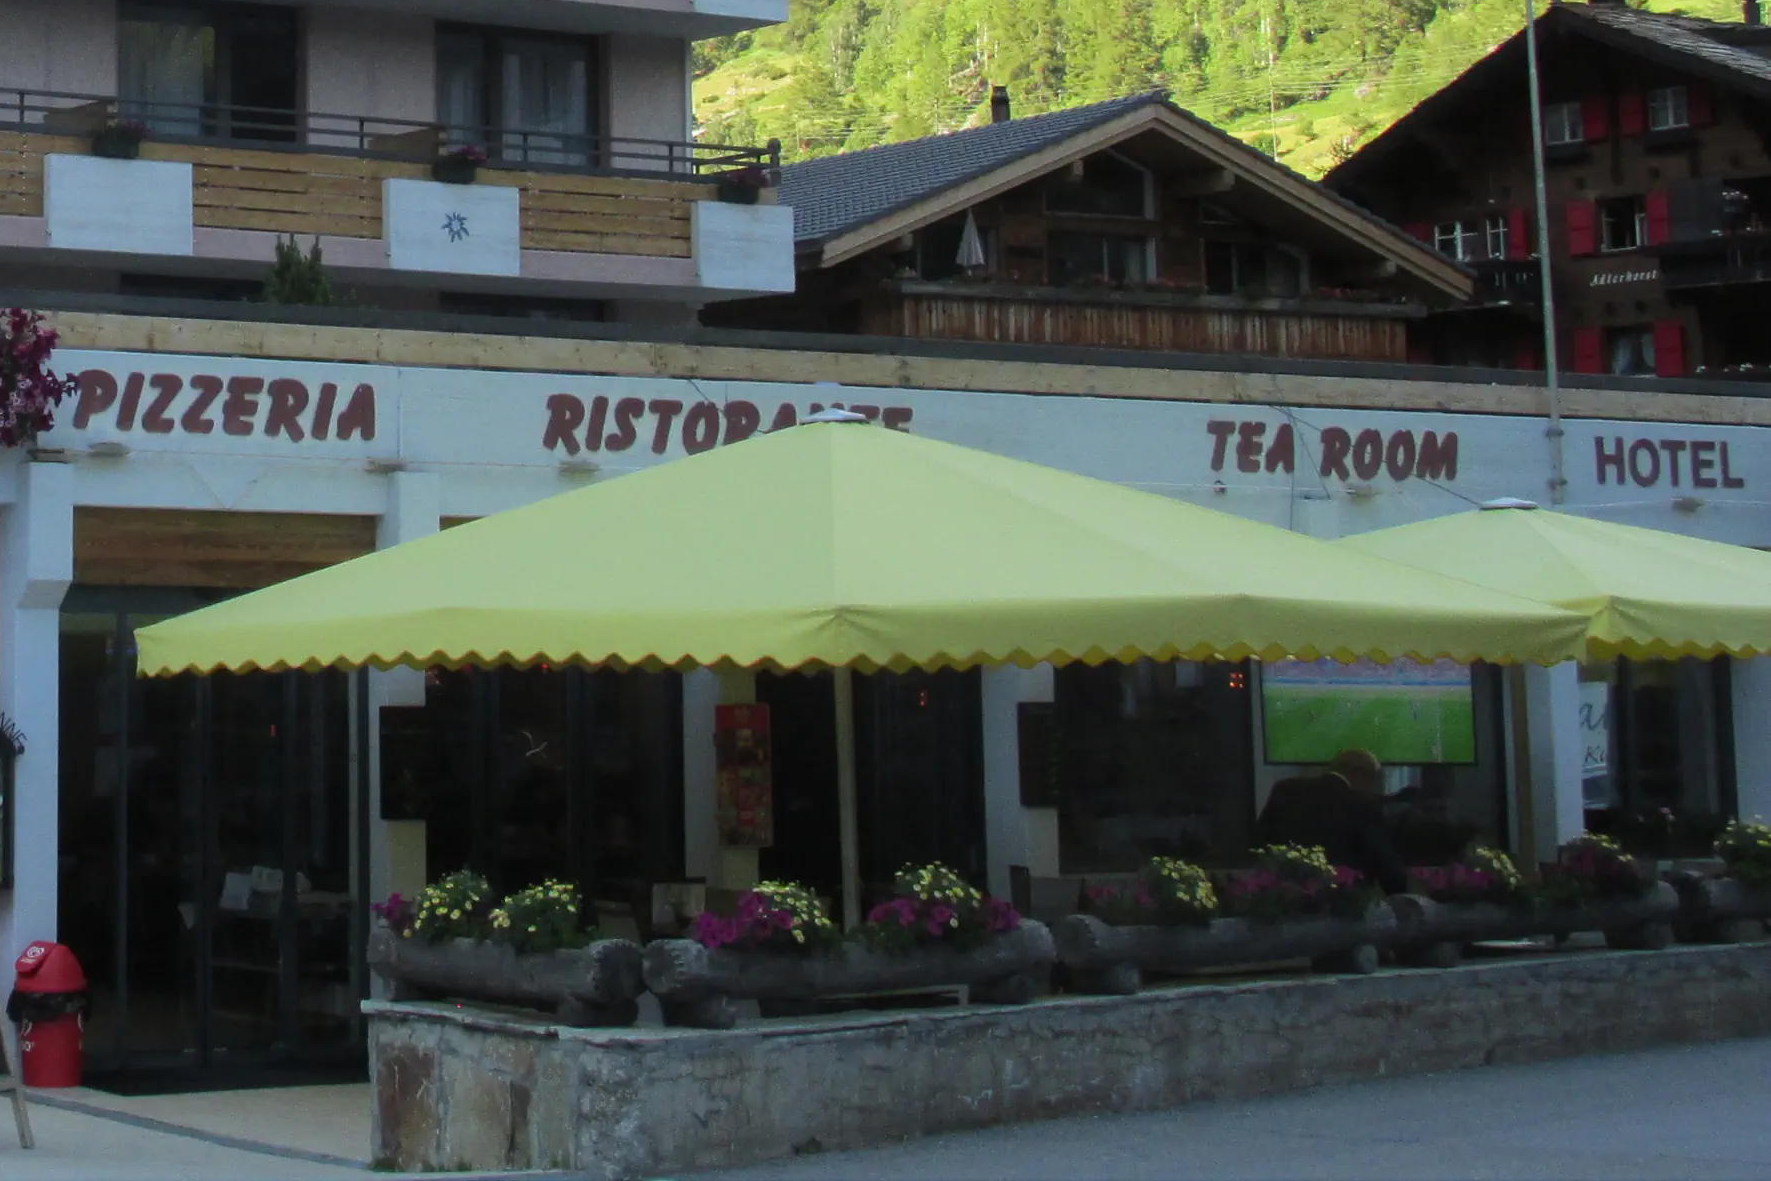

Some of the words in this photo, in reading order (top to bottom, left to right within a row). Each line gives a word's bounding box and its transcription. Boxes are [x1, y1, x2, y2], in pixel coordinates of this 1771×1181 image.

[73, 368, 377, 443] PIZZERIA
[542, 393, 914, 456] RISTOR
[1206, 420, 1295, 473] TEA
[1320, 428, 1459, 482] ROOM
[1595, 436, 1745, 489] HOTEL
